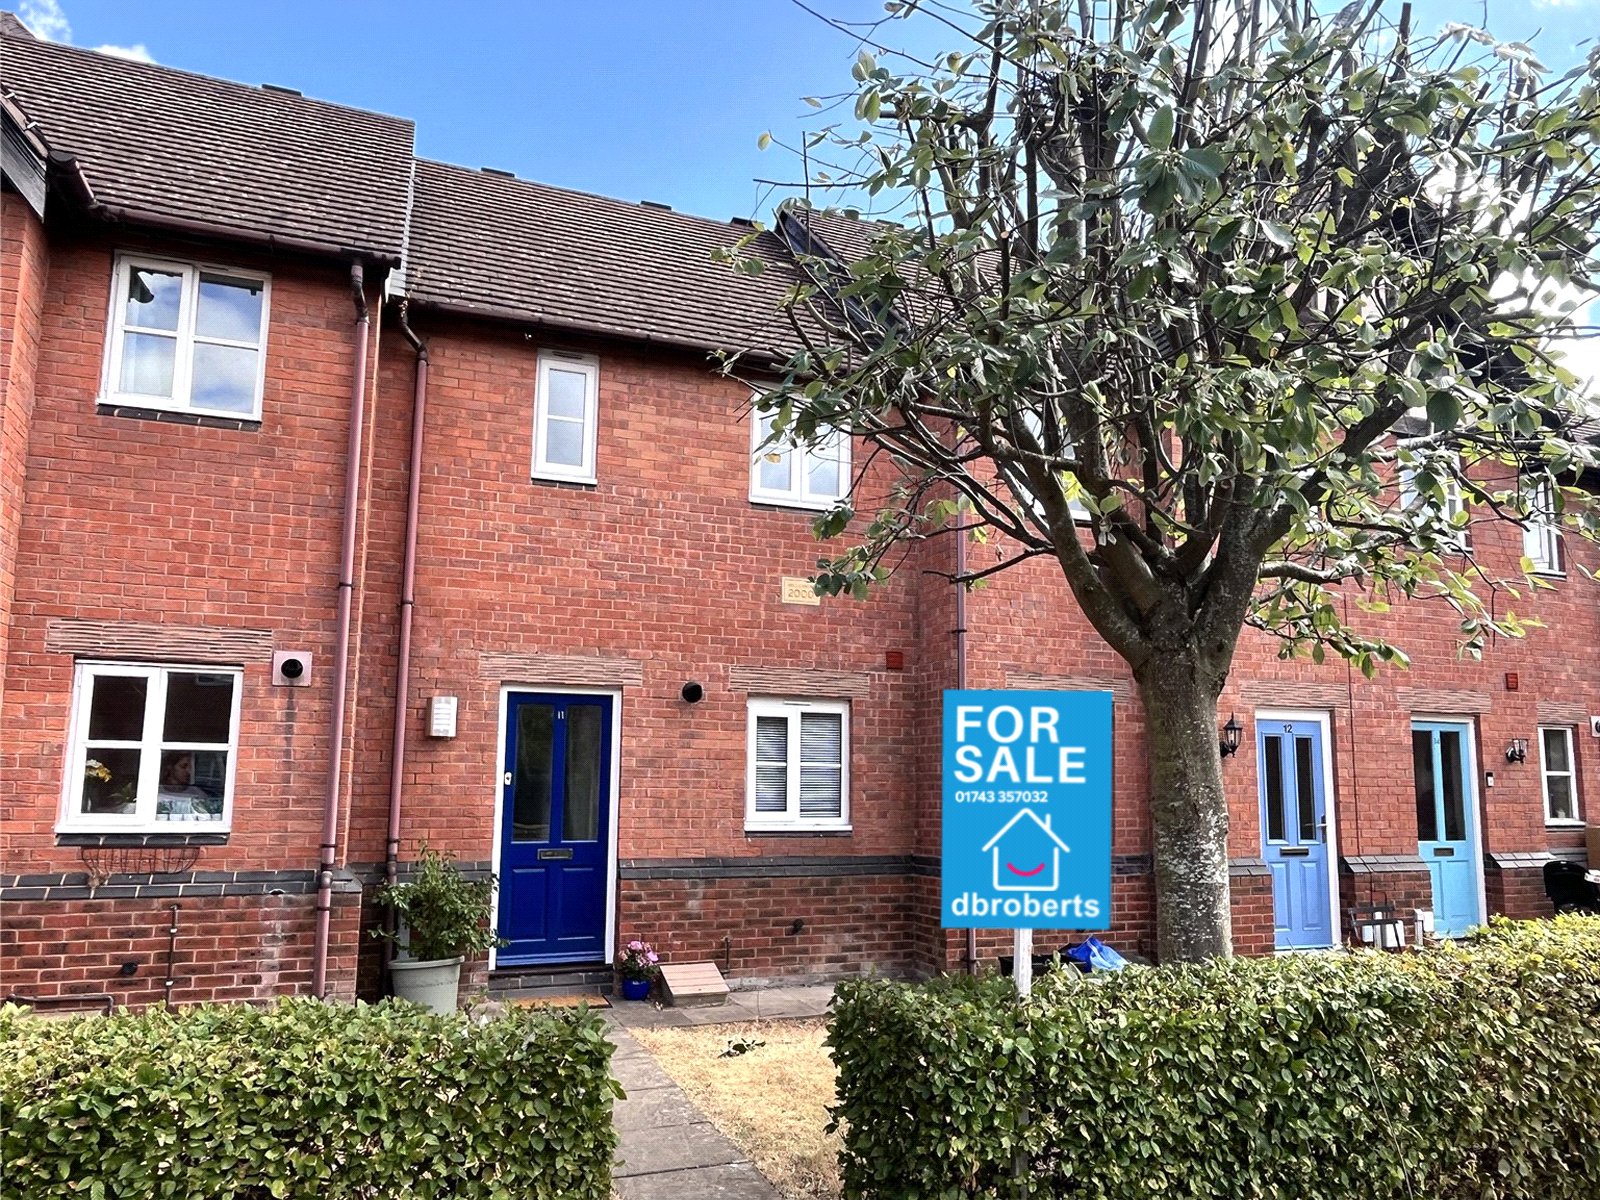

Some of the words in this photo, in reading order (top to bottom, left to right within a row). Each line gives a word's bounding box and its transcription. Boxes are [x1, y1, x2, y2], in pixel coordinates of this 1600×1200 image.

[788, 588, 814, 599] 2000
[557, 710, 565, 720] 11
[956, 705, 1059, 743] FOR
[1283, 723, 1293, 733] 12
[954, 745, 1086, 783] SALE
[955, 790, 995, 803] 01743
[997, 790, 1048, 803] 357032
[951, 892, 1100, 918] dbroberts
